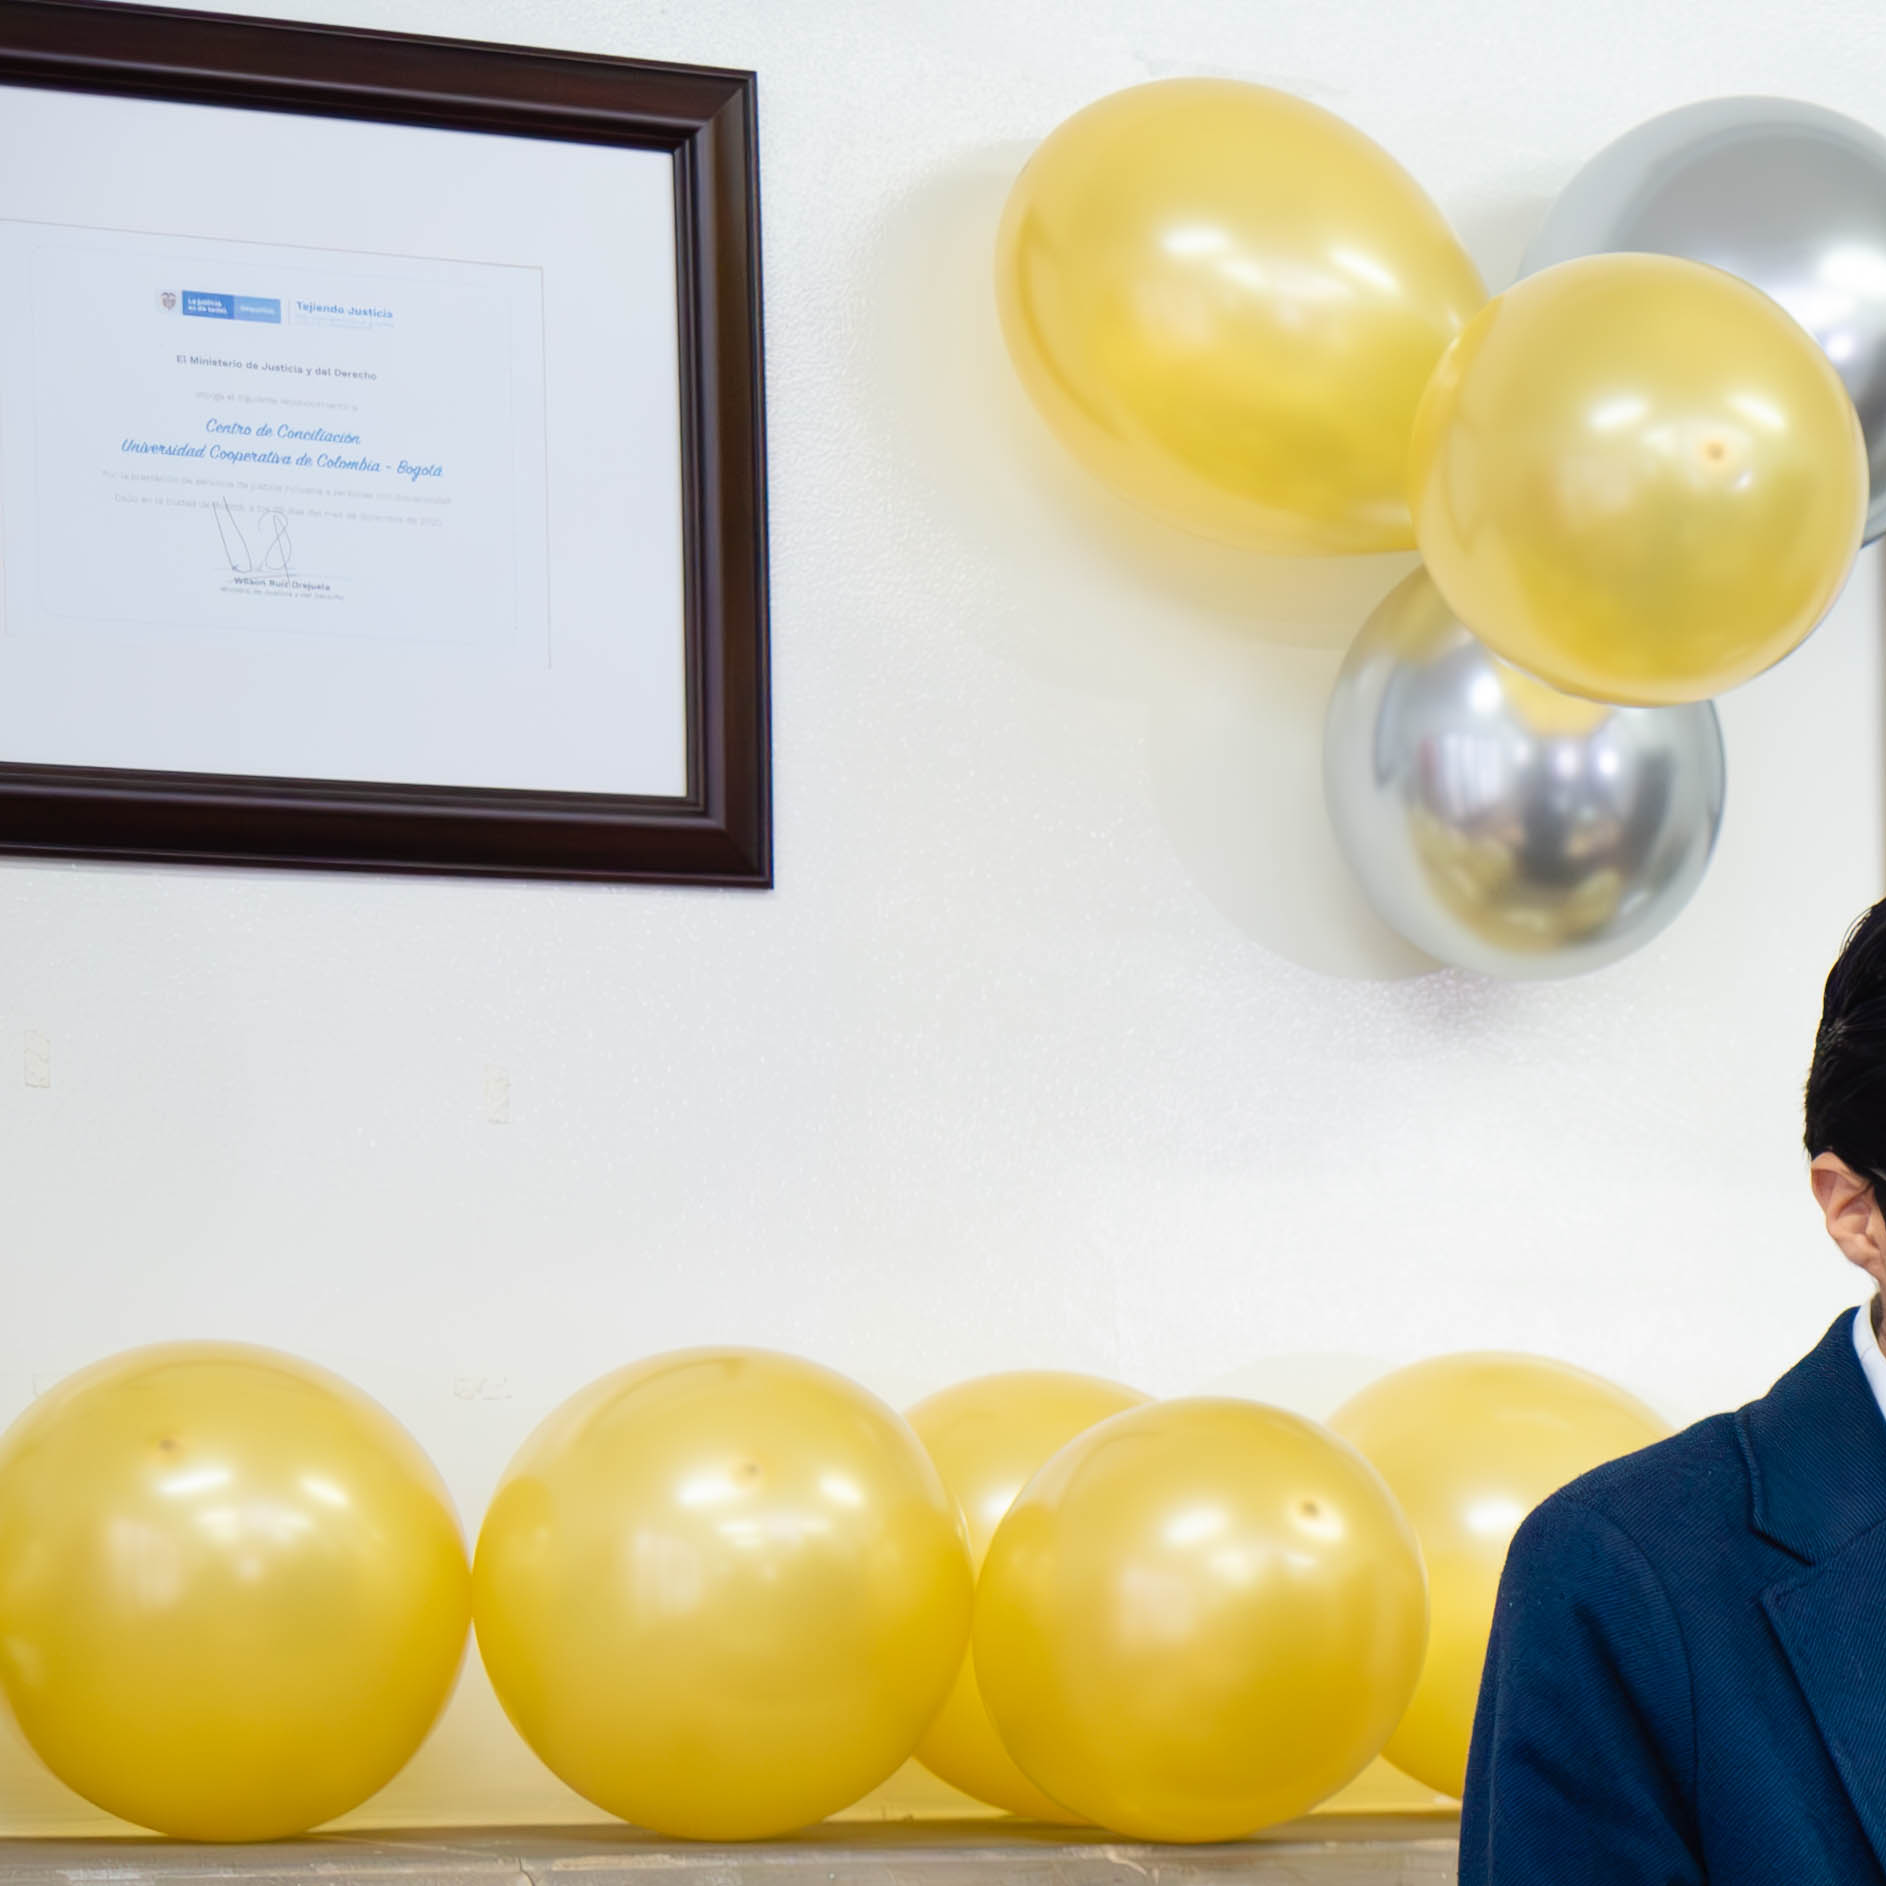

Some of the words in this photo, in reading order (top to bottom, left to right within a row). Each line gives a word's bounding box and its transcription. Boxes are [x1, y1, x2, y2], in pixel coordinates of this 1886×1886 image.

[348, 305, 392, 319] Justicia
[190, 355, 242, 368] Ministerio
[246, 360, 258, 370] de
[261, 362, 303, 375] Justicia
[334, 368, 377, 381] Derecho
[206, 418, 252, 435] Centro
[255, 423, 273, 437] de
[277, 424, 361, 444] Conciliación
[121, 438, 207, 458] Universidad
[210, 444, 291, 465] Cooperativa
[295, 452, 312, 466] de
[317, 453, 381, 472] Colombia
[397, 460, 443, 482] Bogotá
